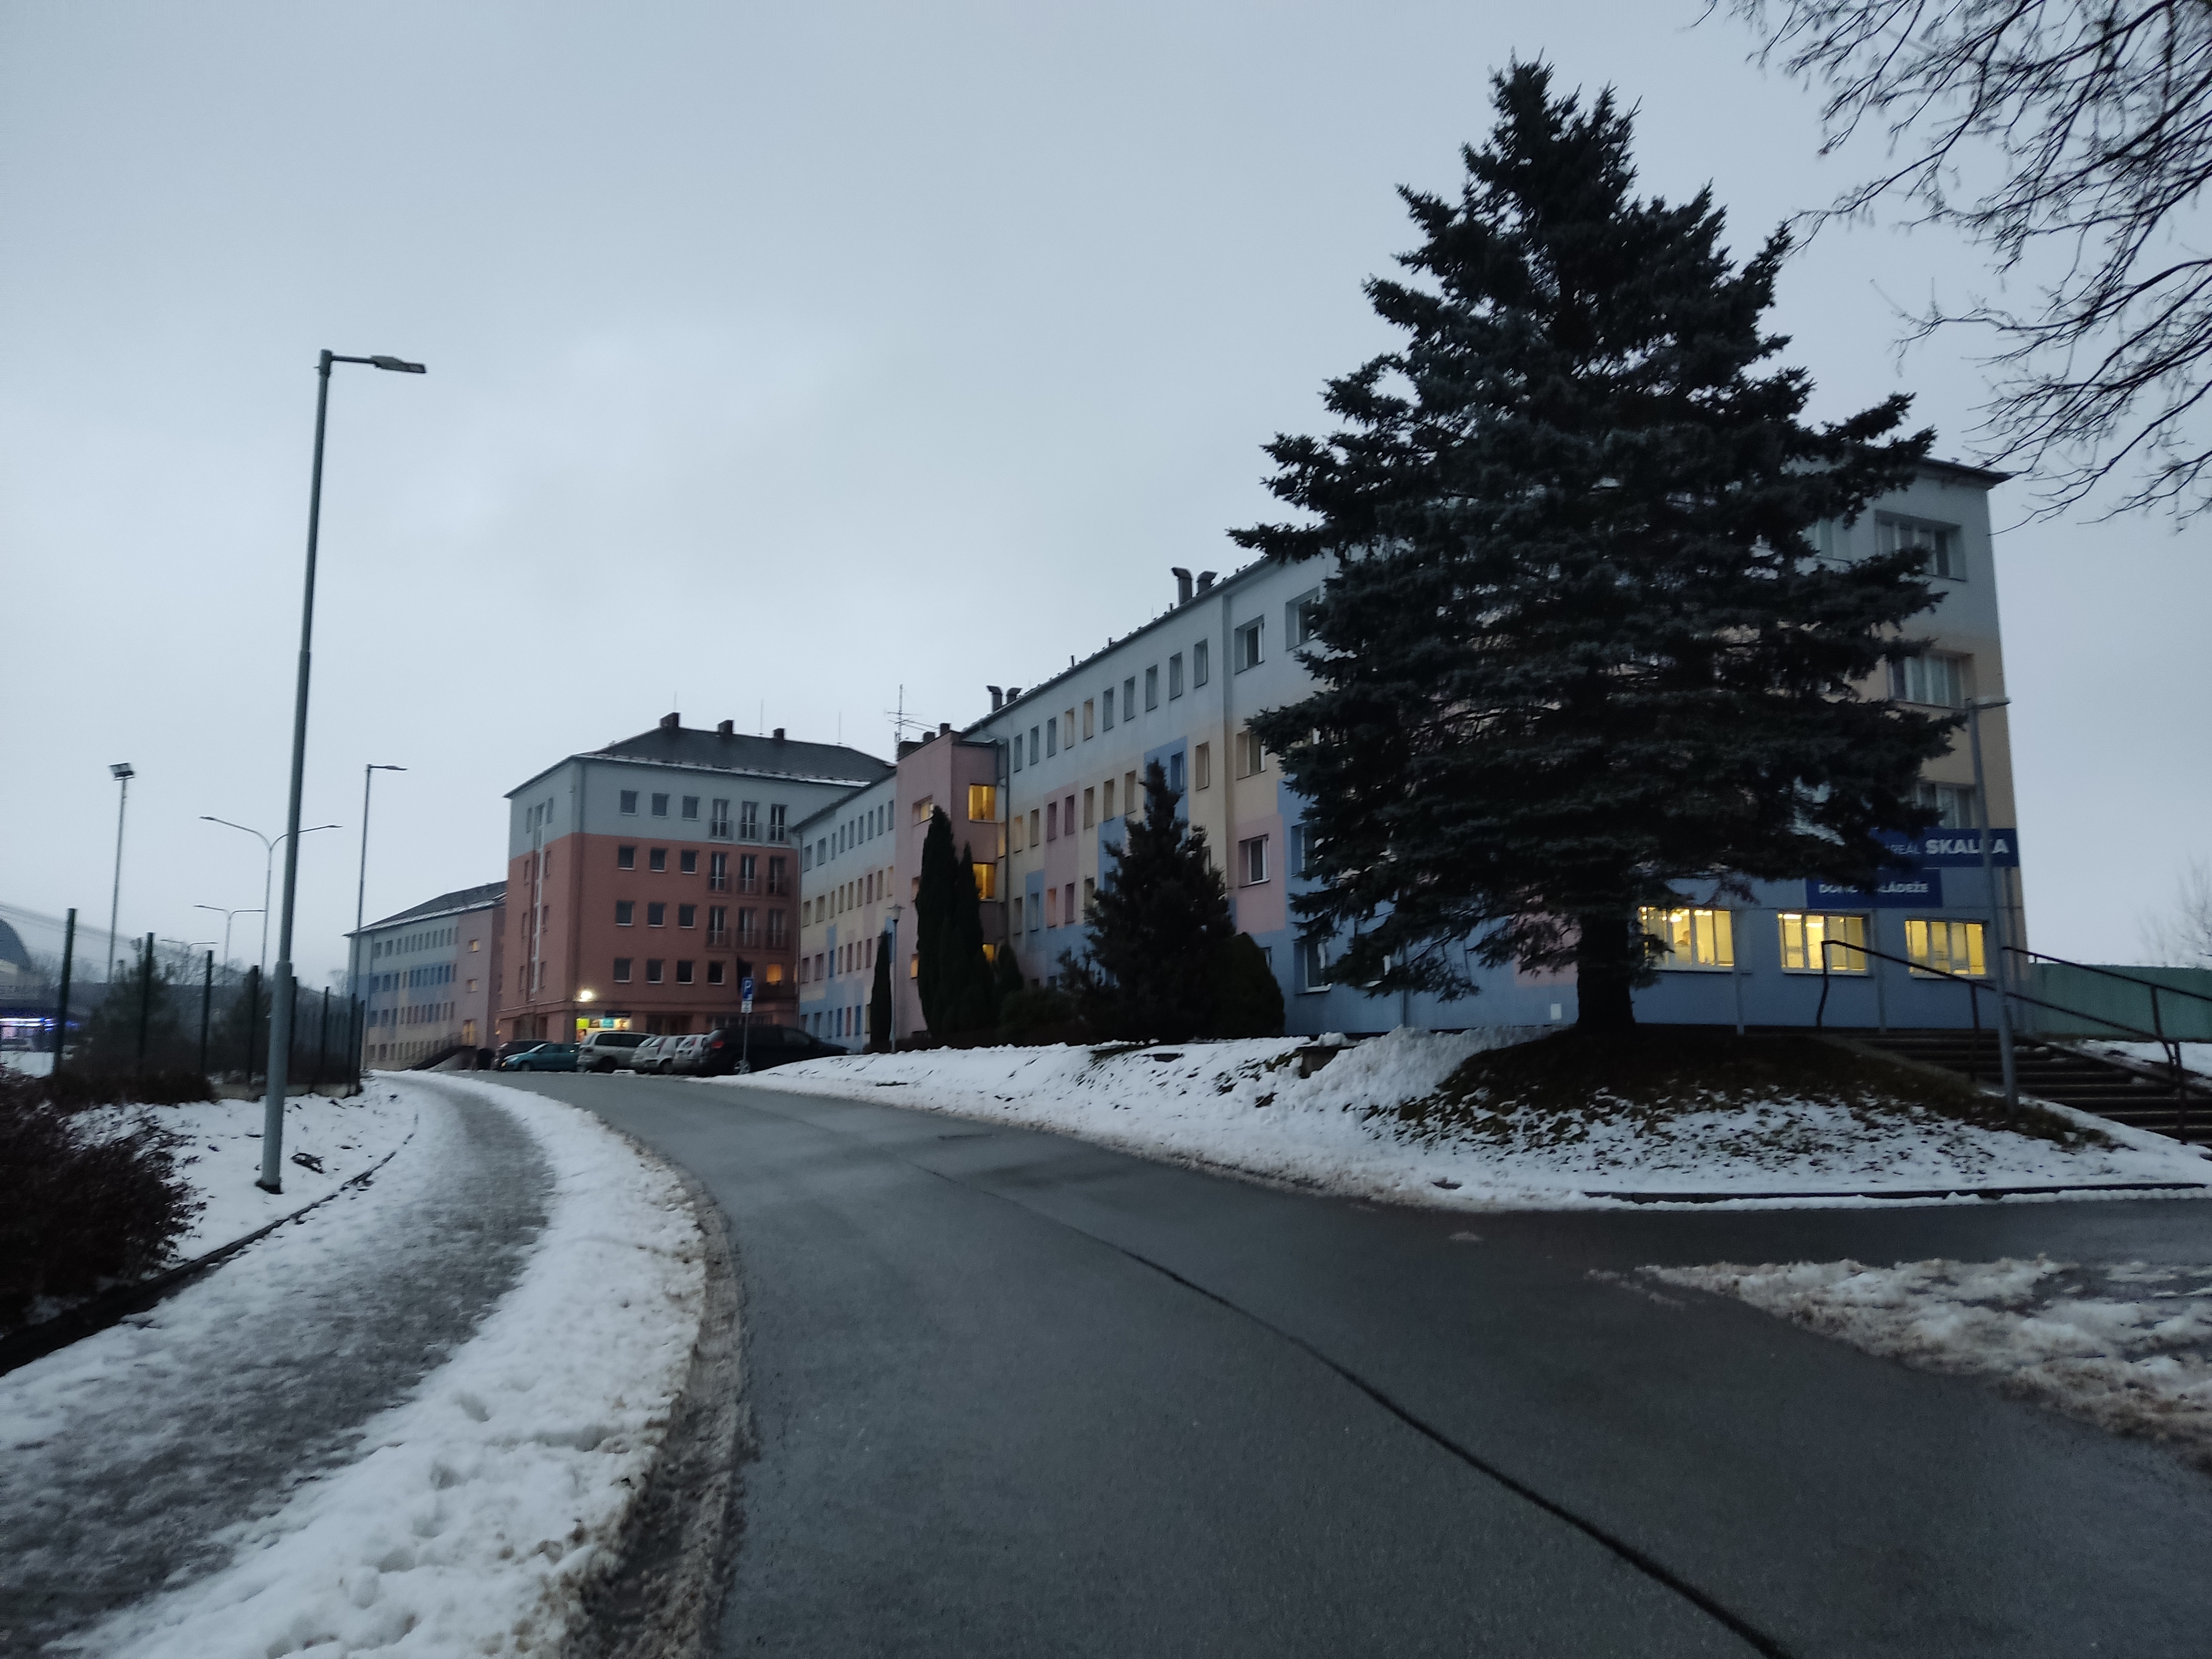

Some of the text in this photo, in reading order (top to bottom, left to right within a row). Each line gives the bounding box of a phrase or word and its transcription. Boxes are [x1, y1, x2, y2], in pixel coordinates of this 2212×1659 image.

[1925, 838, 2010, 854] SKALA
[1873, 881, 1929, 893] LÁDEŽE
[744, 980, 752, 993] P
